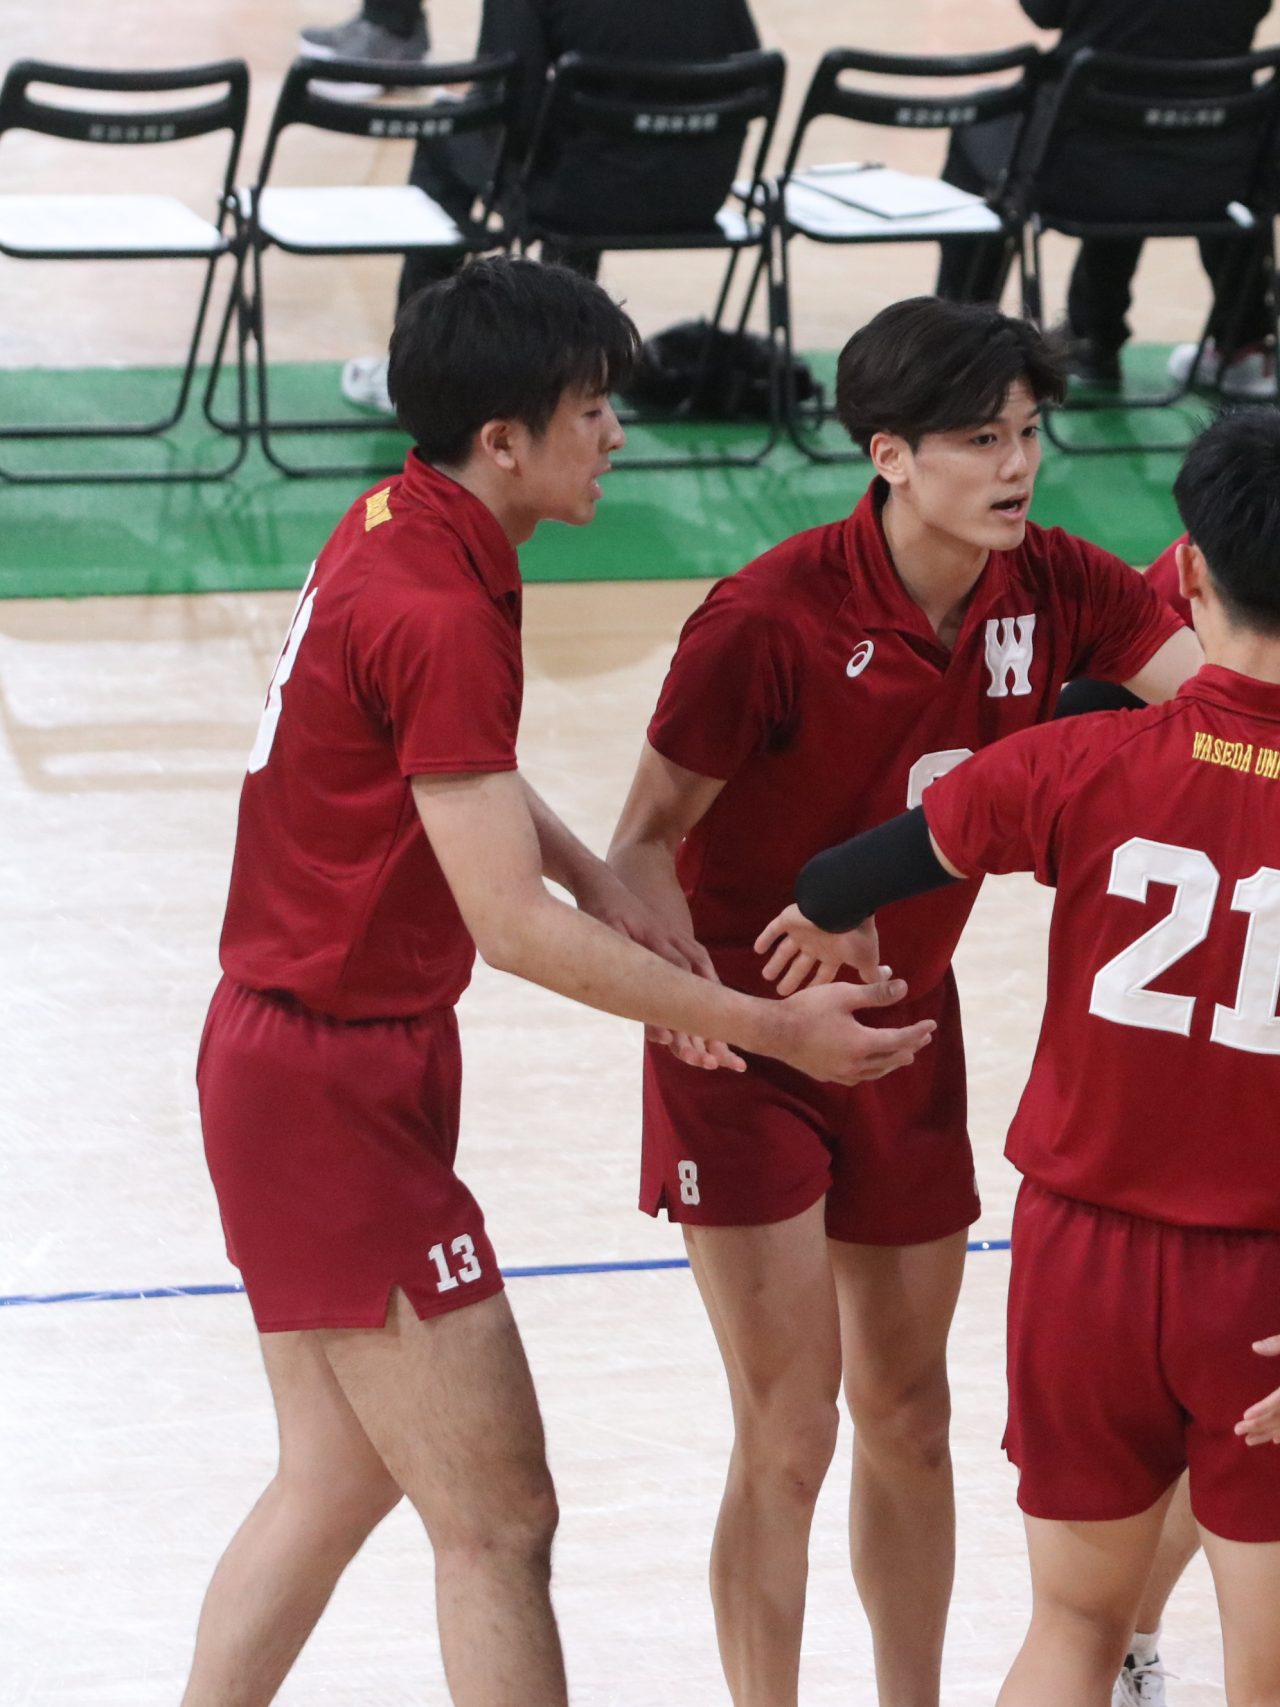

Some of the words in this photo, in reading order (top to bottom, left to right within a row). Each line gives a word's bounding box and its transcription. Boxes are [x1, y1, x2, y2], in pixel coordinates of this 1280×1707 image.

[985, 613, 1037, 698] W
[1192, 731, 1254, 775] WASEDA
[677, 1159, 701, 1207] 8
[427, 1233, 483, 1294] 13
